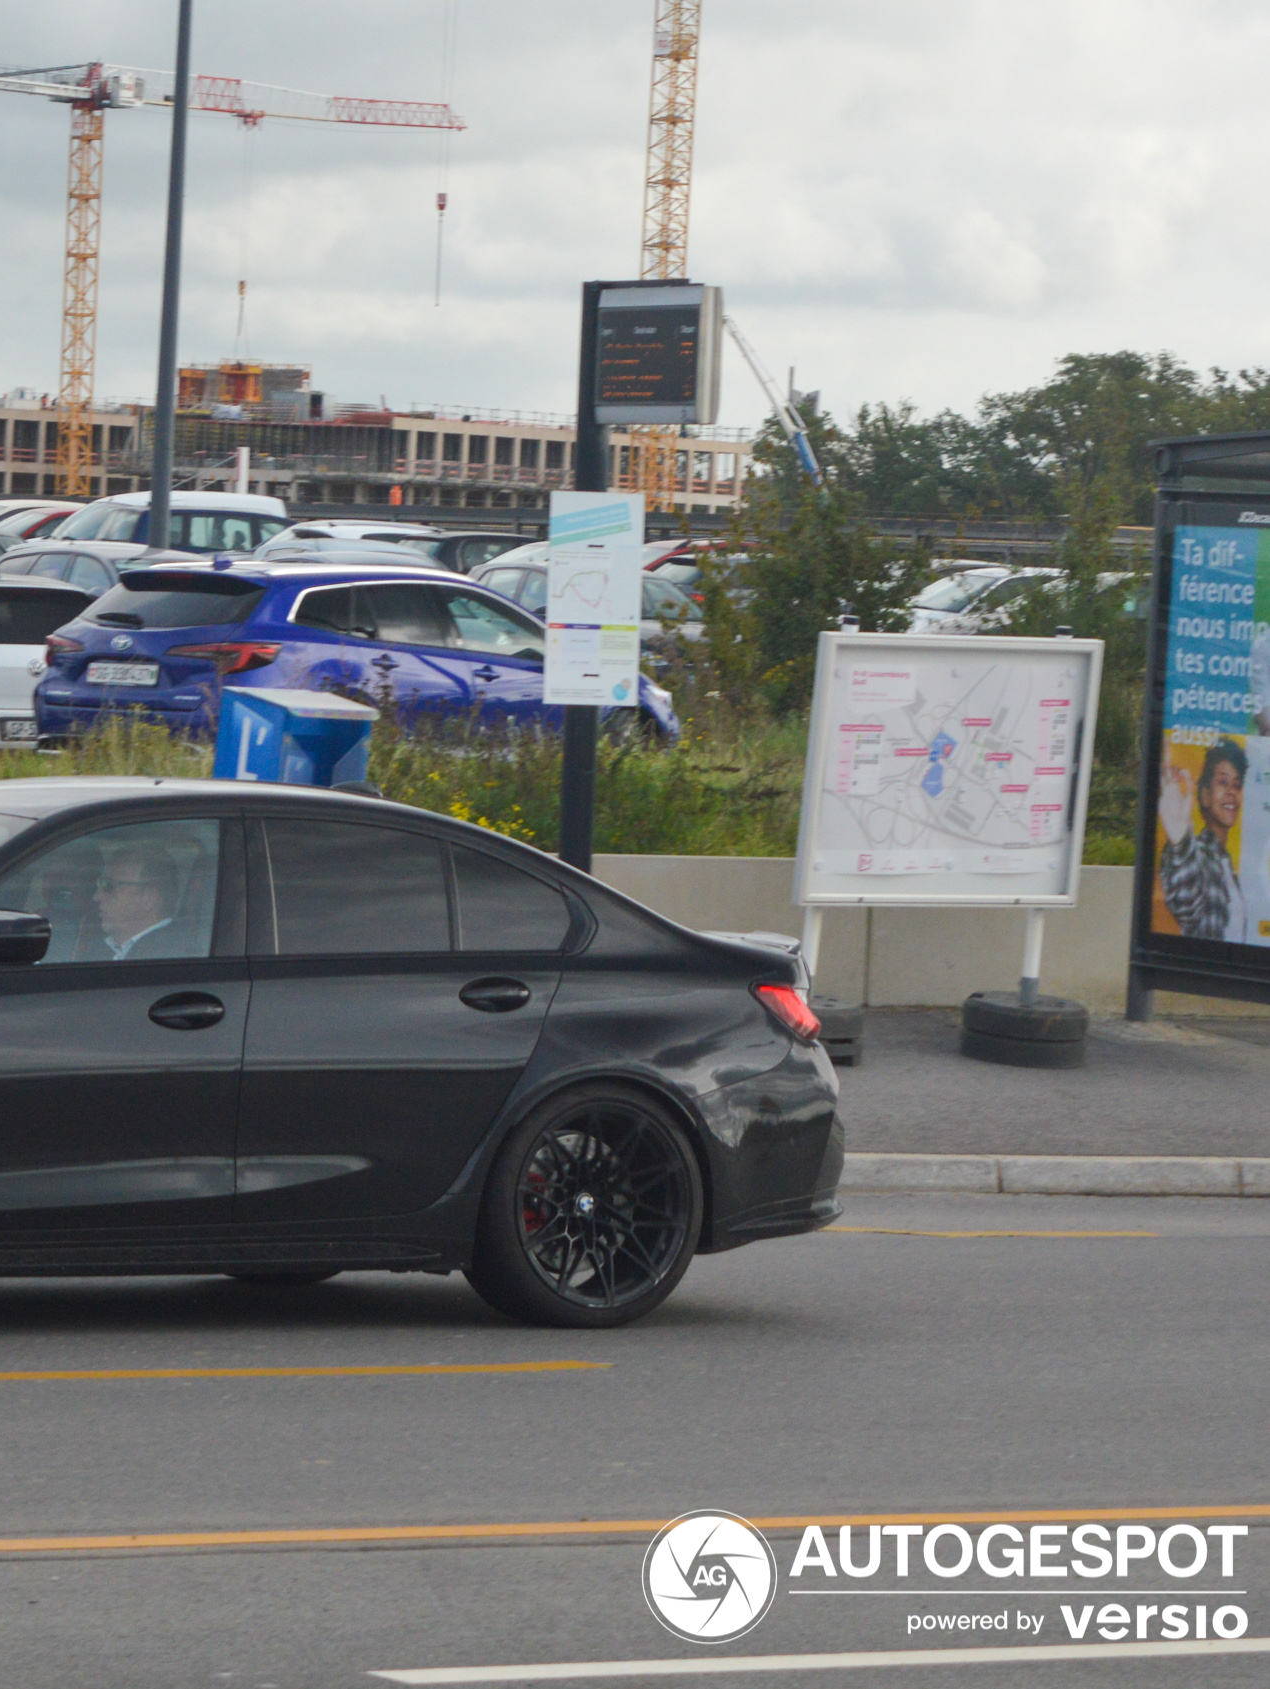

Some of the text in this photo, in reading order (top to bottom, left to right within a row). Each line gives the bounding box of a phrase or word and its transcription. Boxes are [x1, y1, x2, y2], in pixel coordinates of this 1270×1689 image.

[1181, 539, 1244, 567] Ta dif-
[1178, 574, 1255, 604] férence
[1176, 617, 1226, 639] nous
[1175, 648, 1205, 674] tes
[1172, 683, 1263, 714] pétences
[1171, 721, 1225, 748] aussi.
